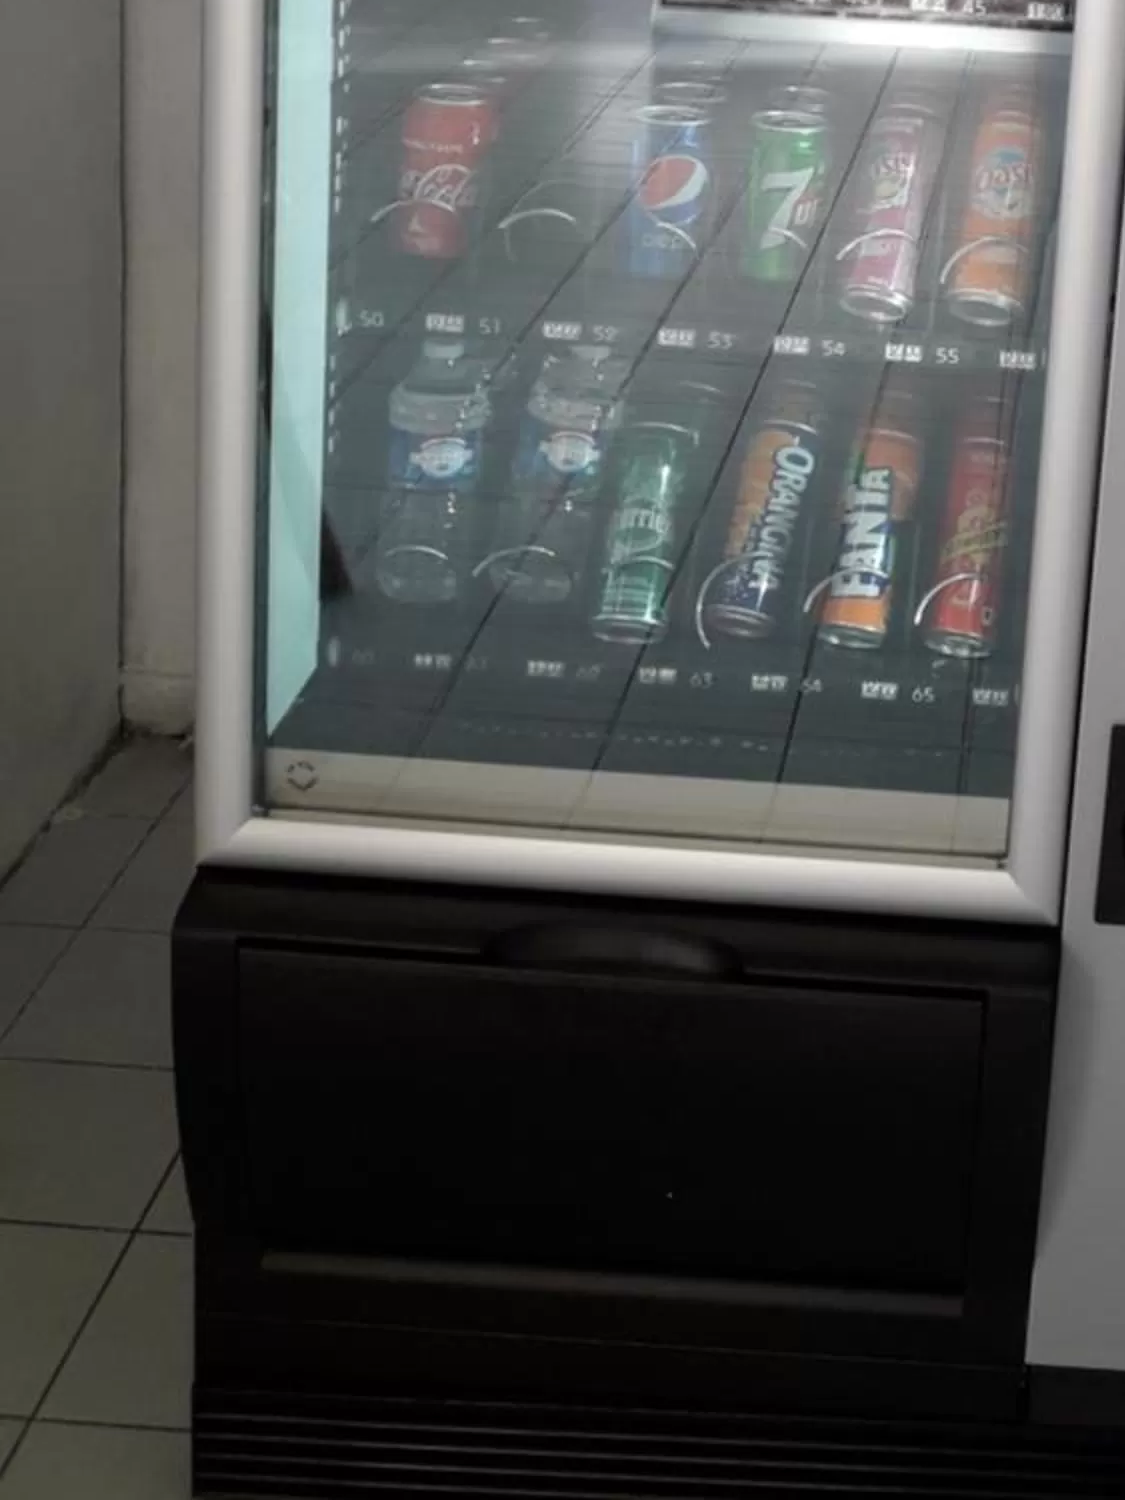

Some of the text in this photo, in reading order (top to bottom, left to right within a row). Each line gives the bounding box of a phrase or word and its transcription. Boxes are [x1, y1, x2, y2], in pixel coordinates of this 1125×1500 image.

[963, 0, 986, 16] 45
[479, 317, 502, 335] 51
[708, 331, 733, 349] 53
[822, 340, 846, 357] 54
[935, 347, 960, 364] 55
[831, 467, 892, 598] FANTA
[912, 686, 936, 703] 65
